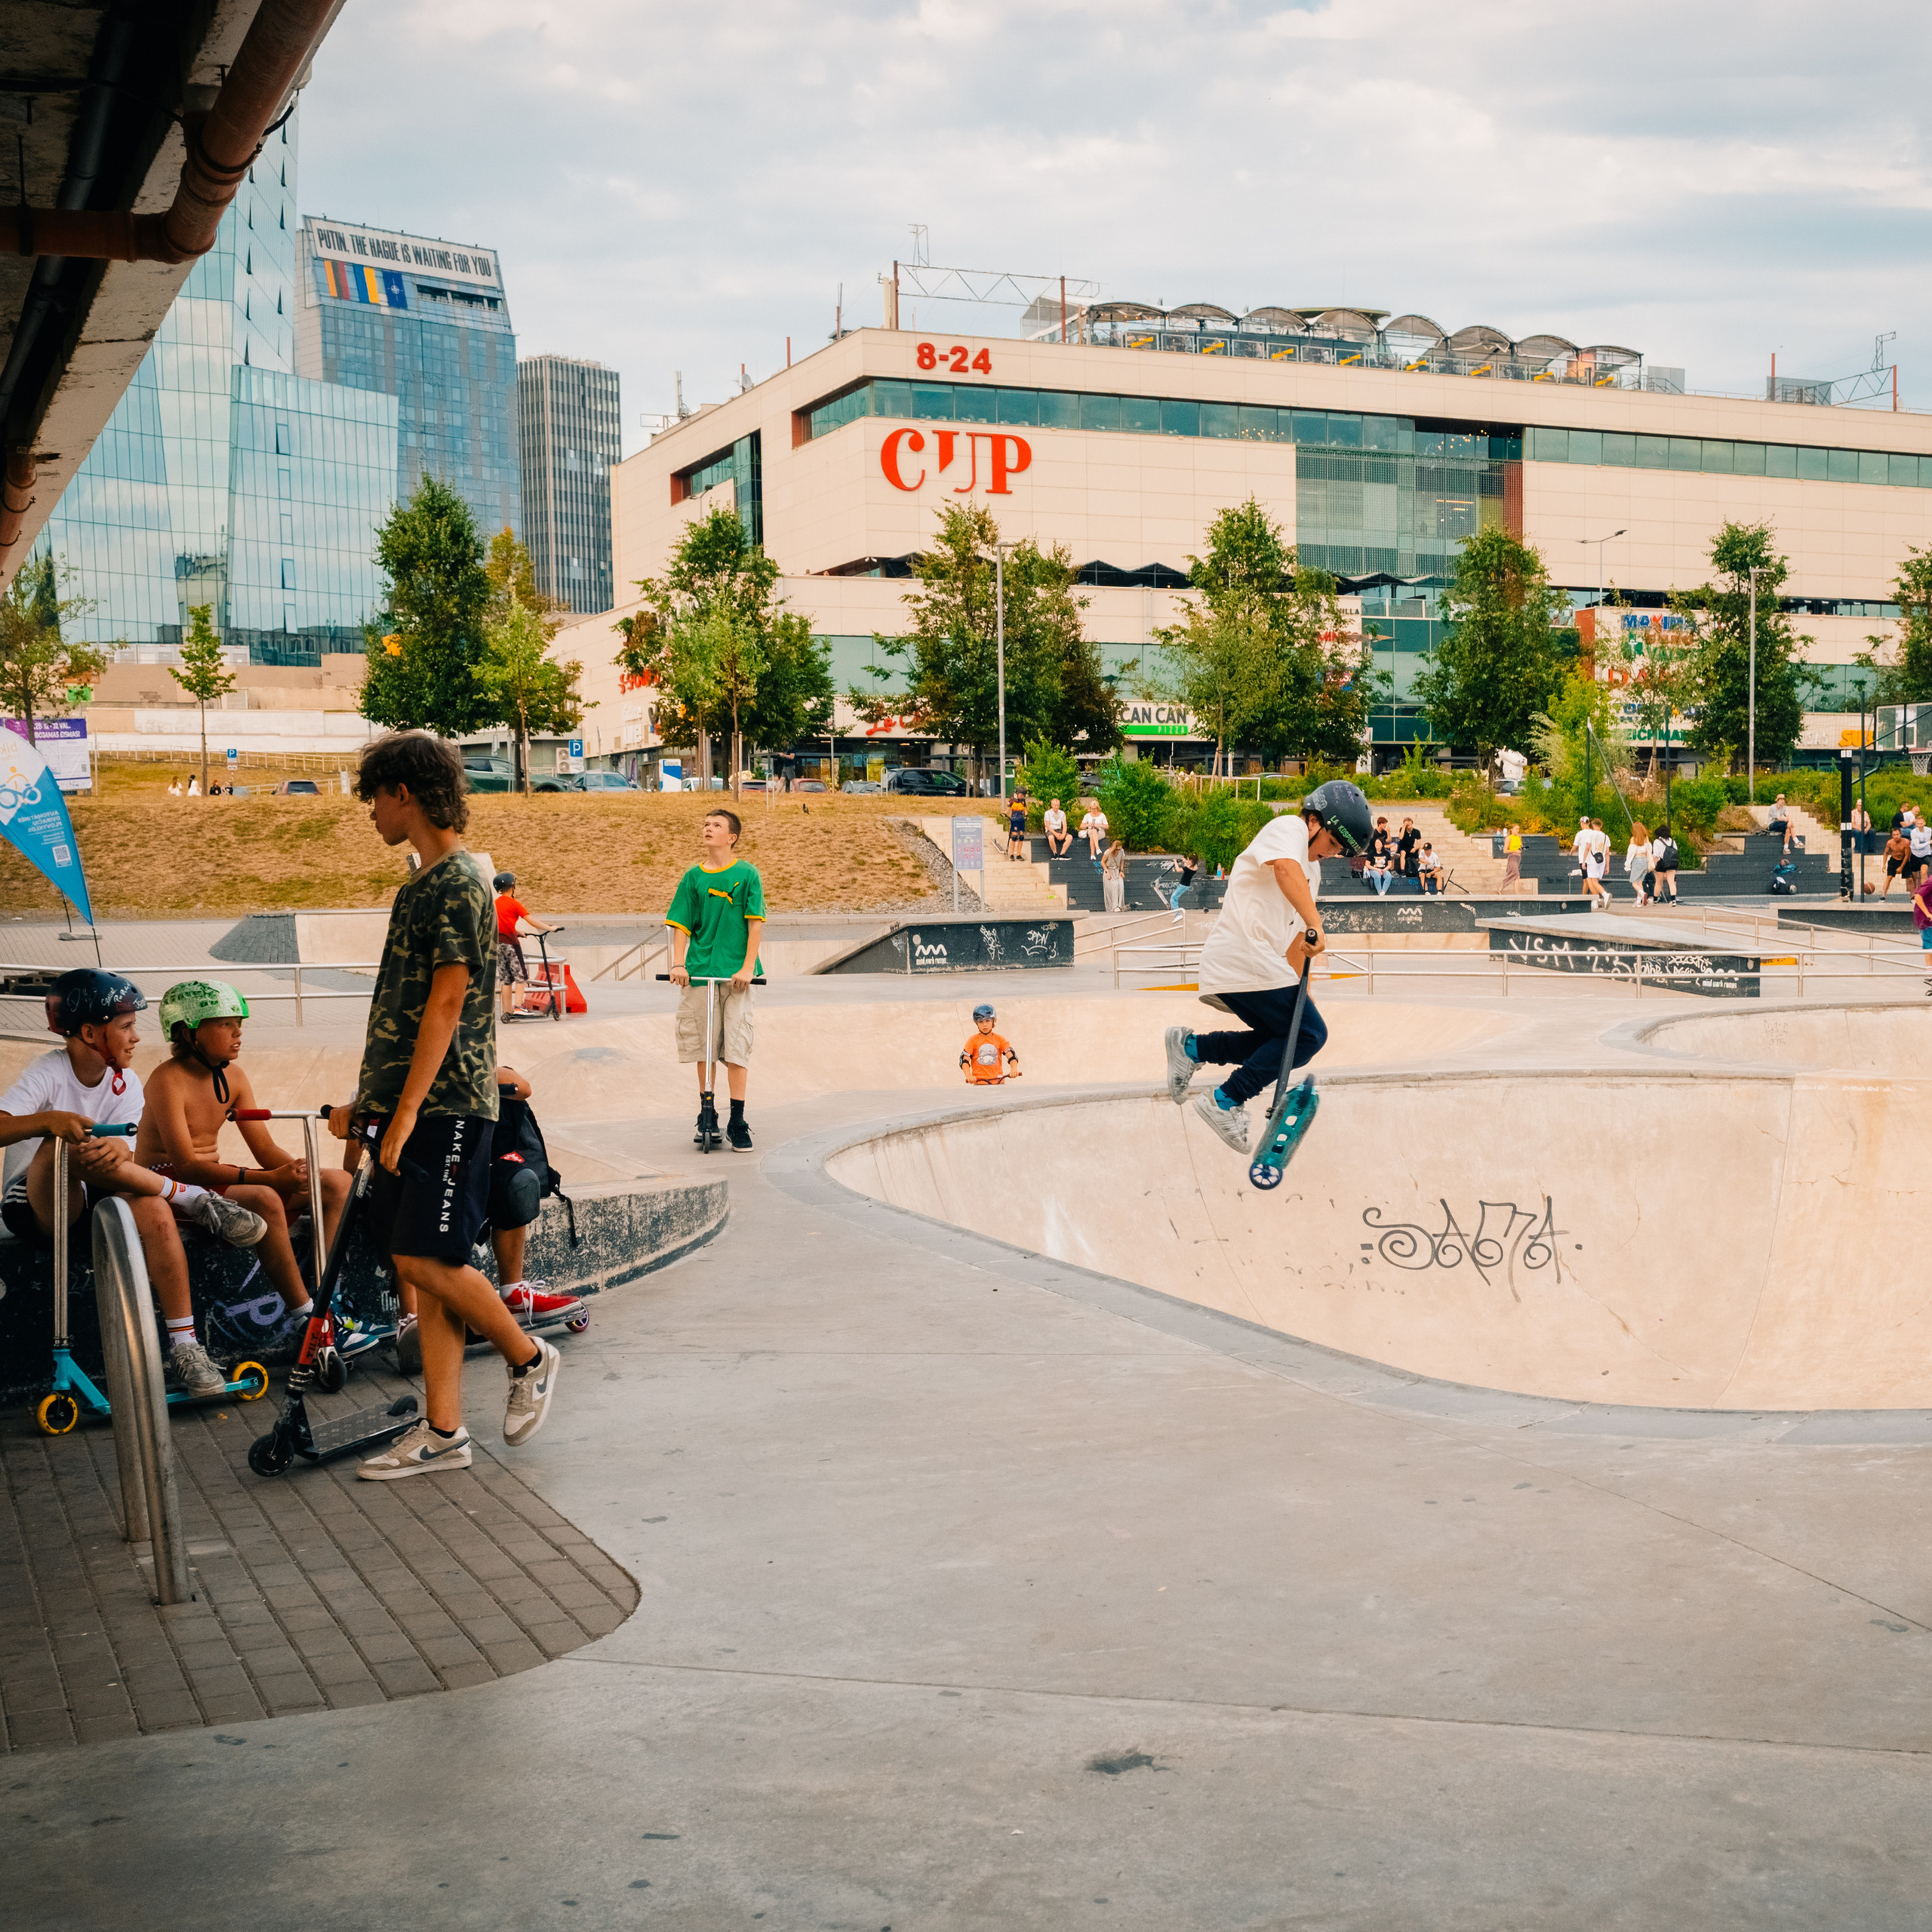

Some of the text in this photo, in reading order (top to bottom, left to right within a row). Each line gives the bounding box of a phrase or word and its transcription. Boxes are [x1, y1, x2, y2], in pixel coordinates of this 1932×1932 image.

[317, 228, 491, 277] PUTIN, THE HAGUE IS WAITING FOR YOU
[916, 343, 992, 374] 8-24
[881, 428, 1032, 494] CUP
[1120, 707, 1186, 724] CAN CAN
[573, 743, 581, 755] P
[1330, 815, 1340, 826] LA
[439, 1178, 456, 1232] JEANS
